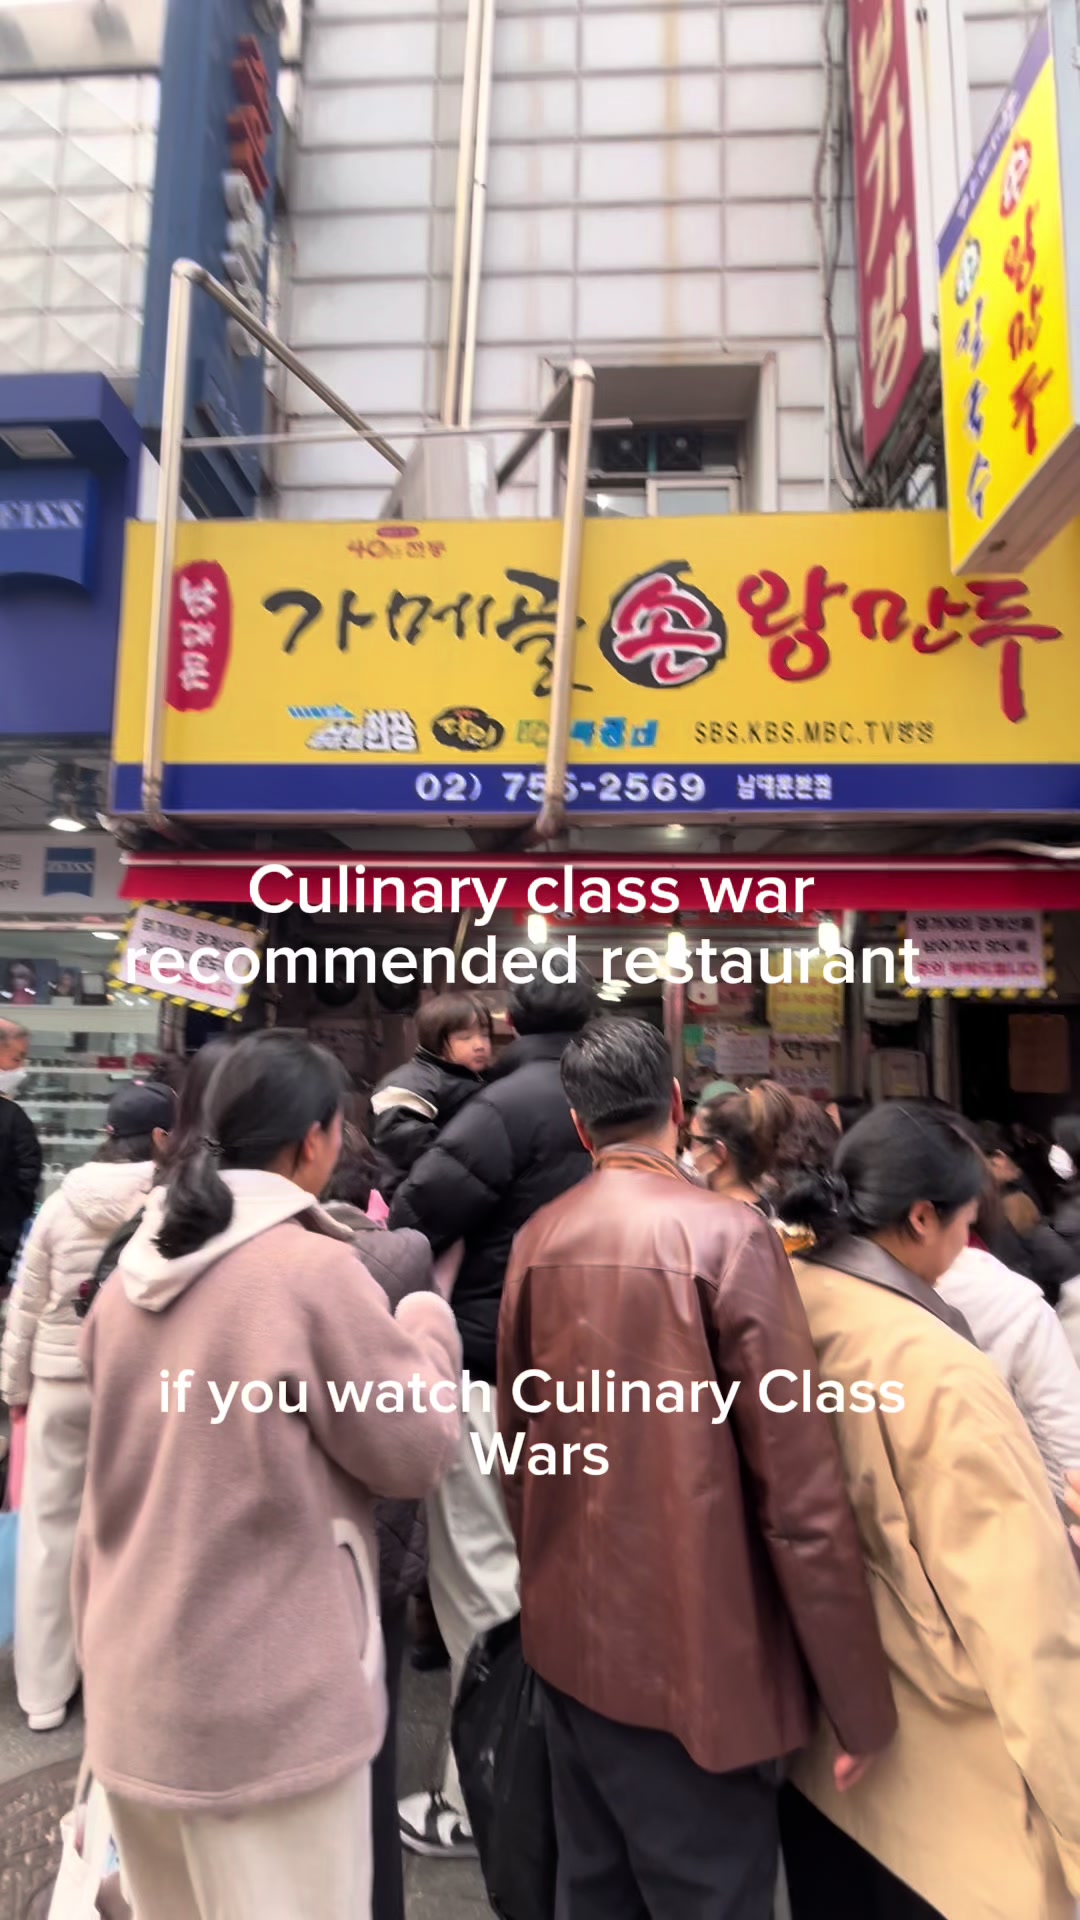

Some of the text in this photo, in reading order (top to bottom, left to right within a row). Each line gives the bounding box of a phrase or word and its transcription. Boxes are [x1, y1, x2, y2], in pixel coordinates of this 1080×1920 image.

[611, 572, 722, 685] 손
[737, 564, 1063, 724] 왕만두
[415, 771, 482, 801] 02)
